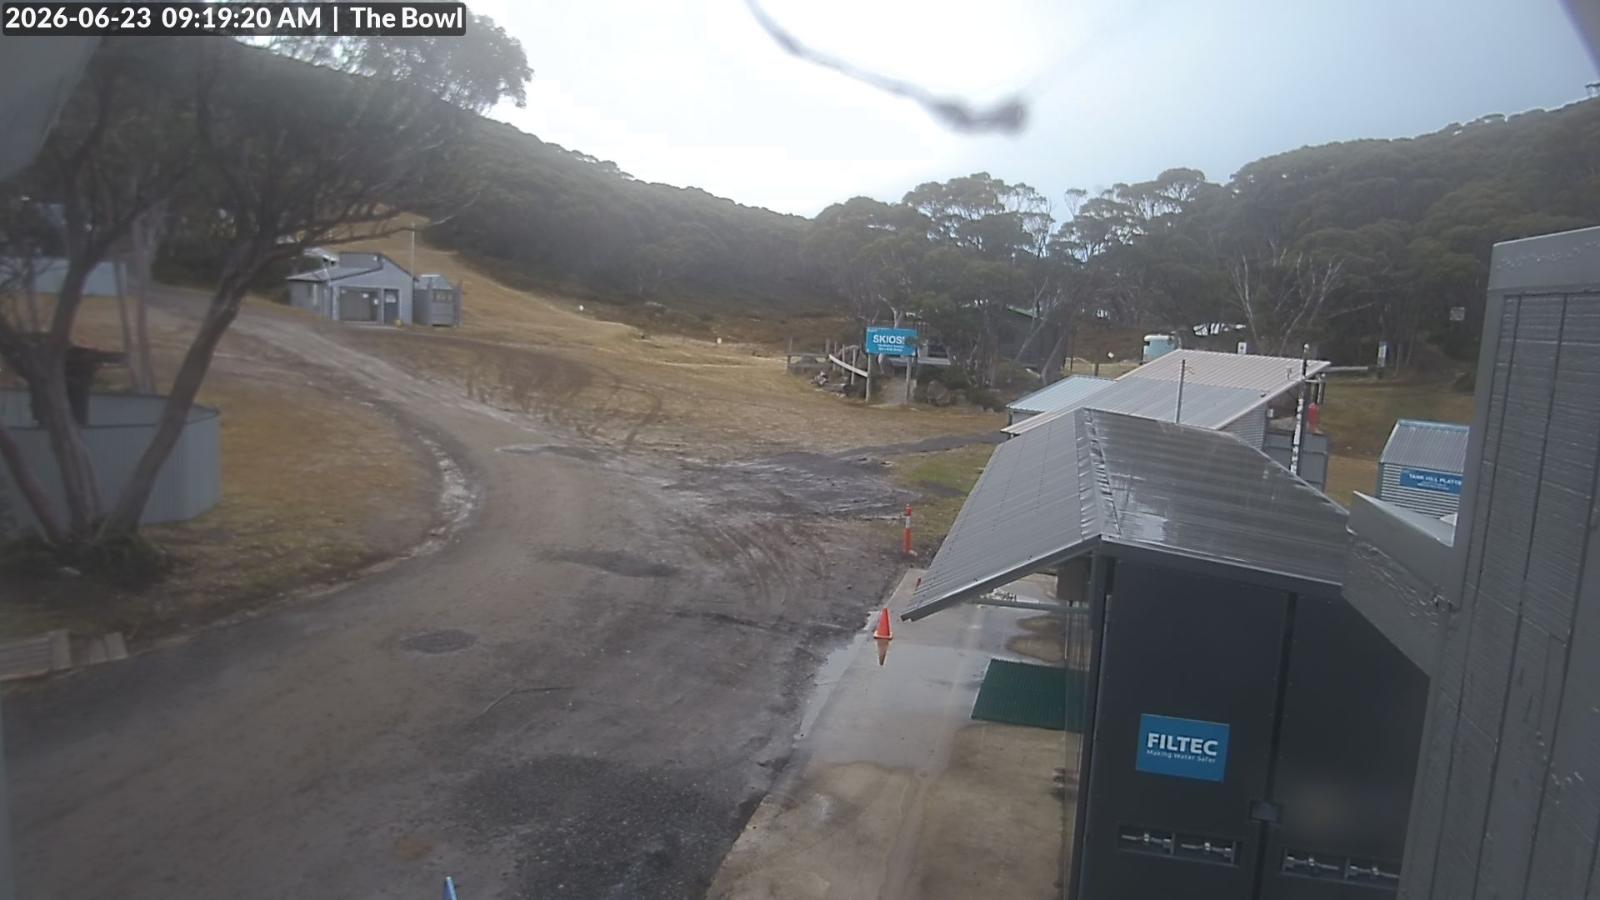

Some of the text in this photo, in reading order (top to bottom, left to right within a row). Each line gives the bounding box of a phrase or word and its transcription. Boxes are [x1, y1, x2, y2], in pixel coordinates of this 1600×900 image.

[1439, 478, 1462, 486] PLATTE
[1147, 732, 1219, 756] FILTEC
[1146, 749, 1216, 763] Making Water Safer
